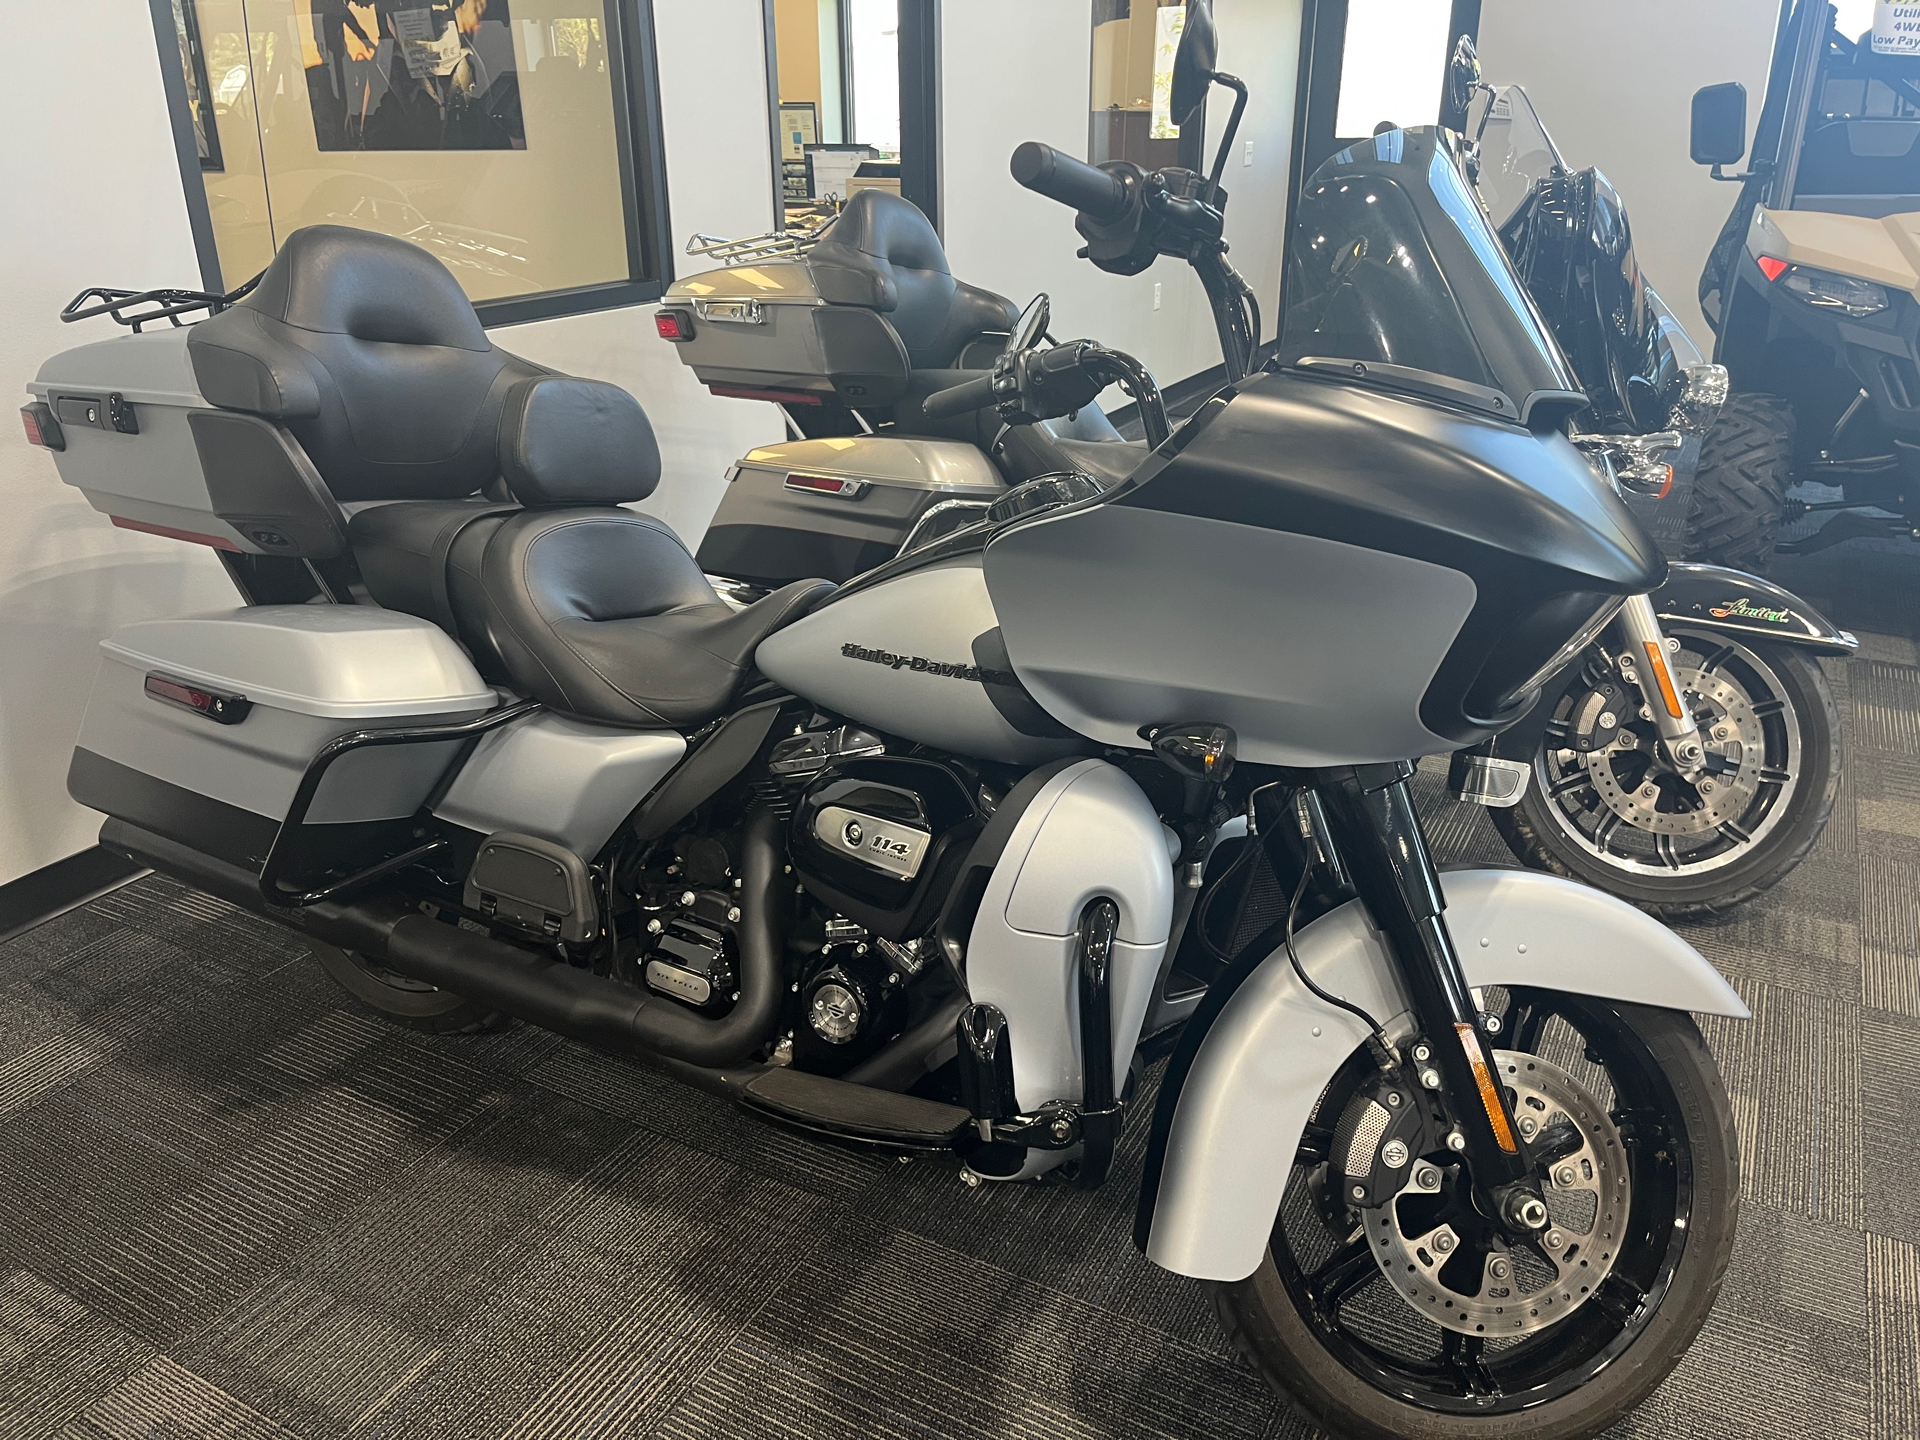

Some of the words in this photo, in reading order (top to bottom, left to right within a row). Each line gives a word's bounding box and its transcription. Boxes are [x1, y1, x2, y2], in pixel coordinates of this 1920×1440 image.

[1873, 35, 1895, 44] Low
[1709, 598, 1789, 623] Limited
[870, 835, 911, 857] 114
